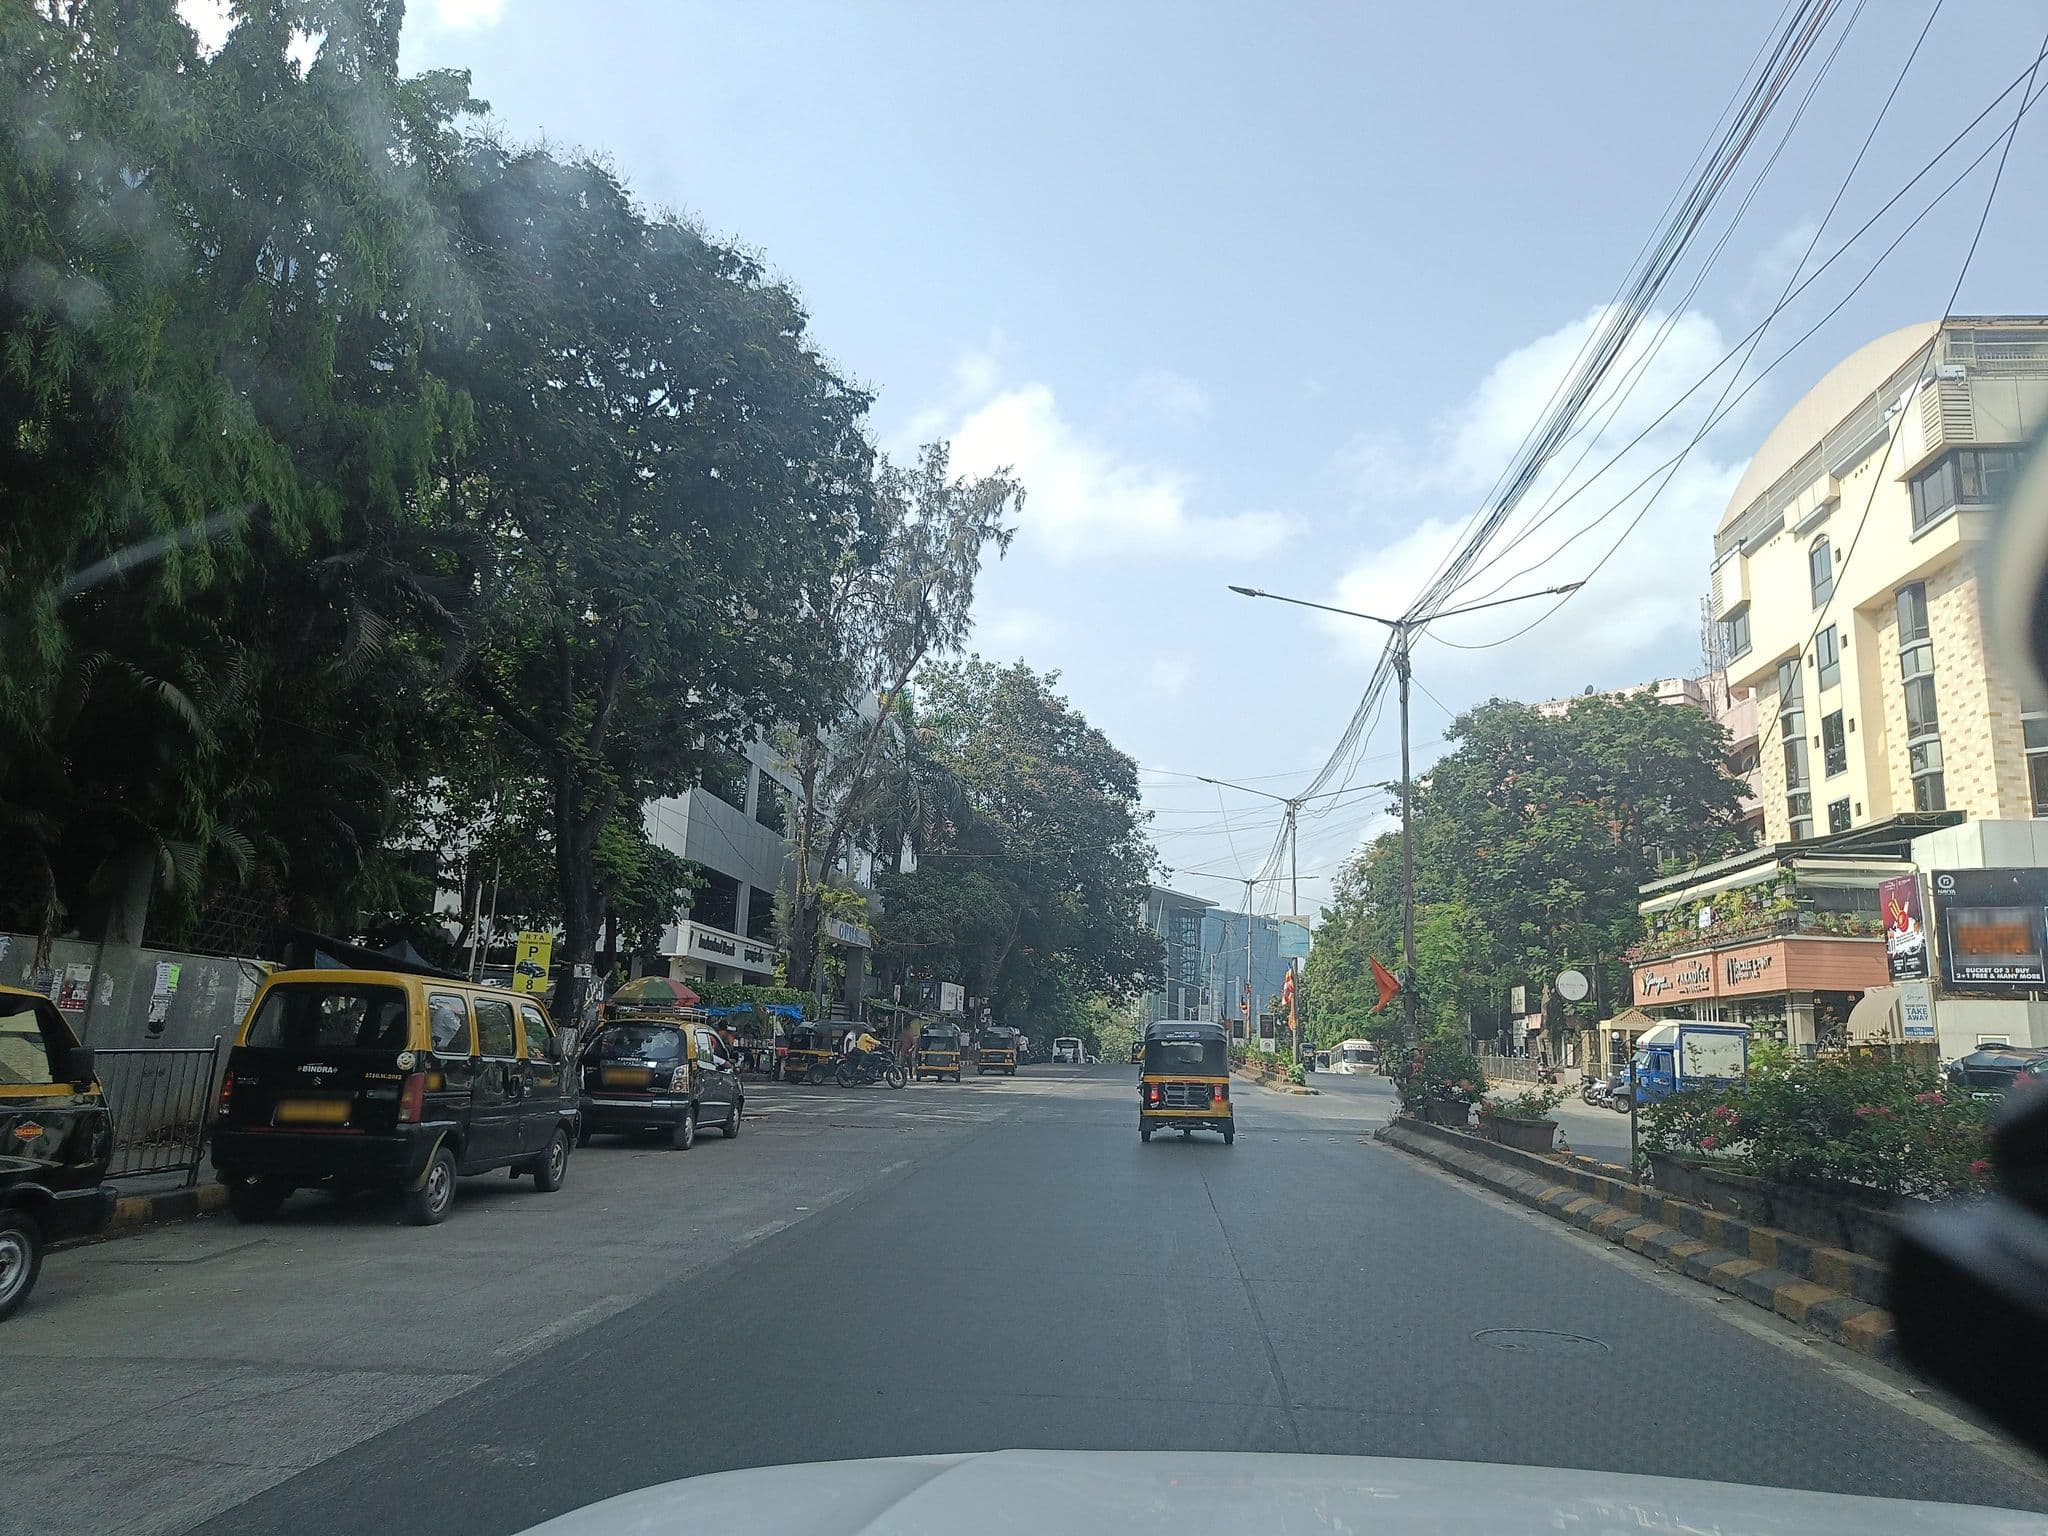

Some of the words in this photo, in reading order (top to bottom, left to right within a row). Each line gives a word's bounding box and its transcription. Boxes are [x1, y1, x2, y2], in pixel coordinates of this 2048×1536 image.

[528, 946, 539, 957] P
[526, 979, 534, 990] 8
[302, 1065, 333, 1073] BINDRA
